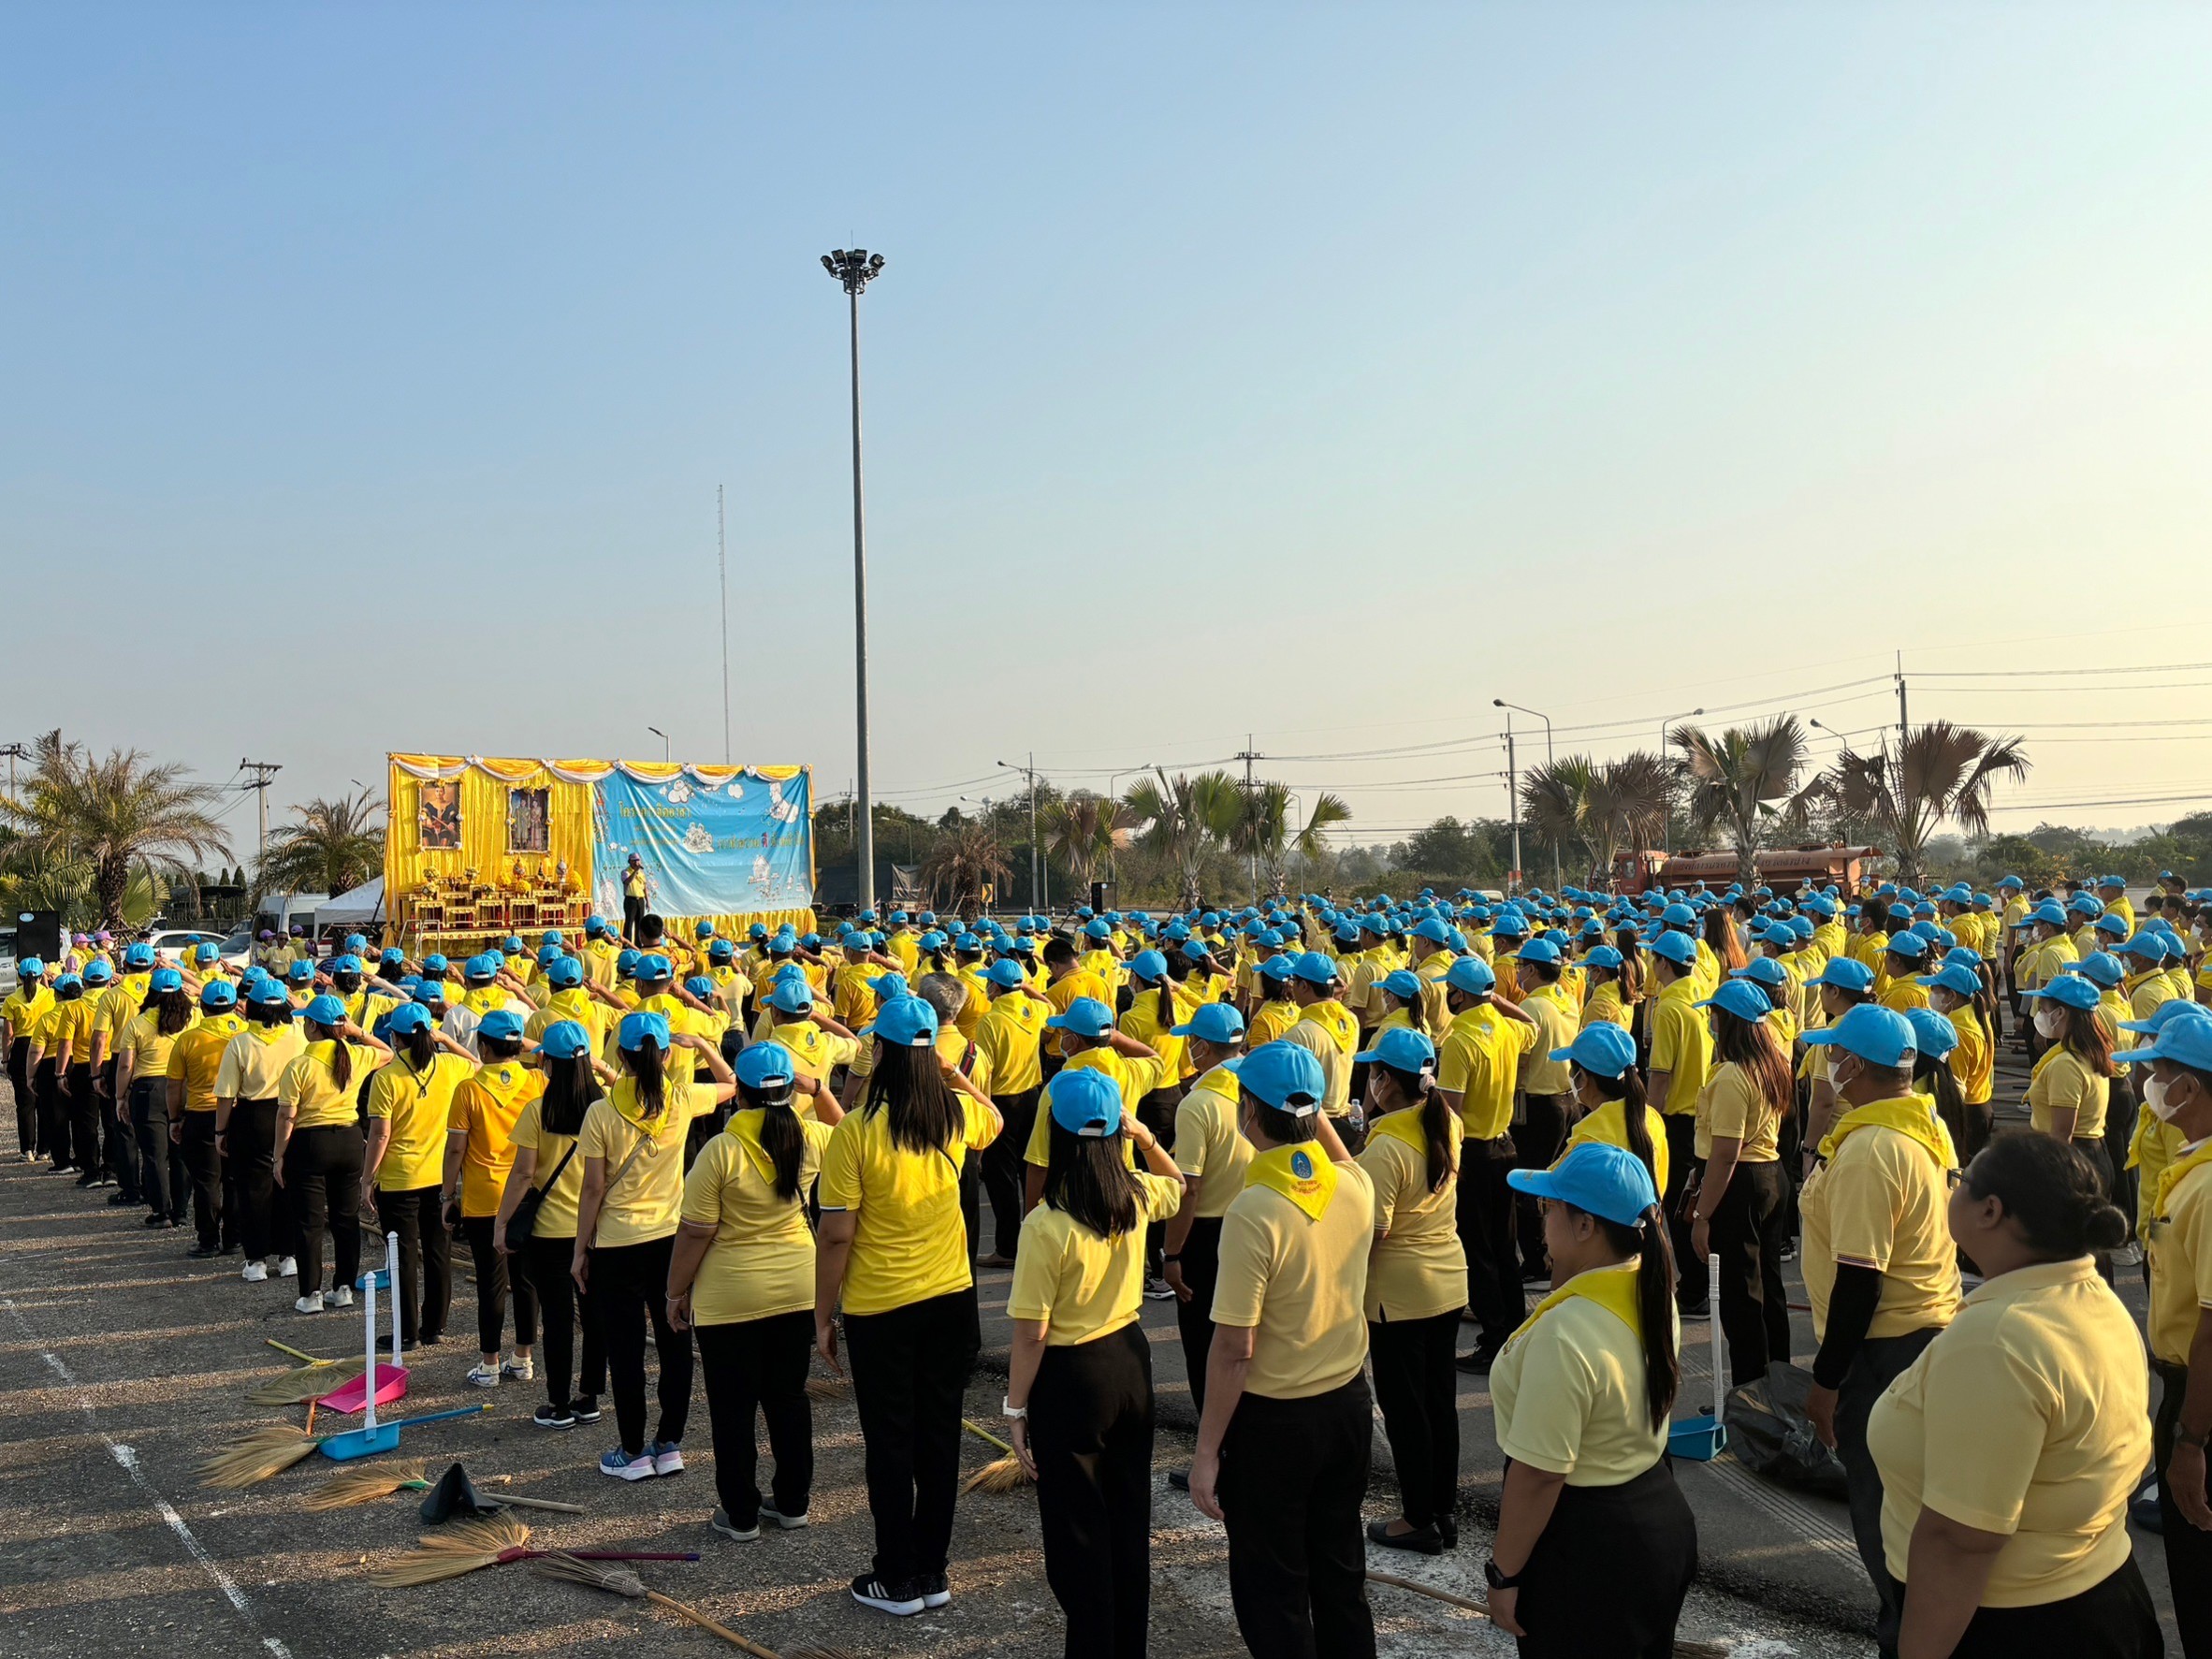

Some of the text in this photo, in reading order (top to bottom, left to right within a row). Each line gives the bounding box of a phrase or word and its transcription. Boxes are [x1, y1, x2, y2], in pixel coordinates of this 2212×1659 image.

[618, 801, 691, 818] โครกาจิตอาสา
